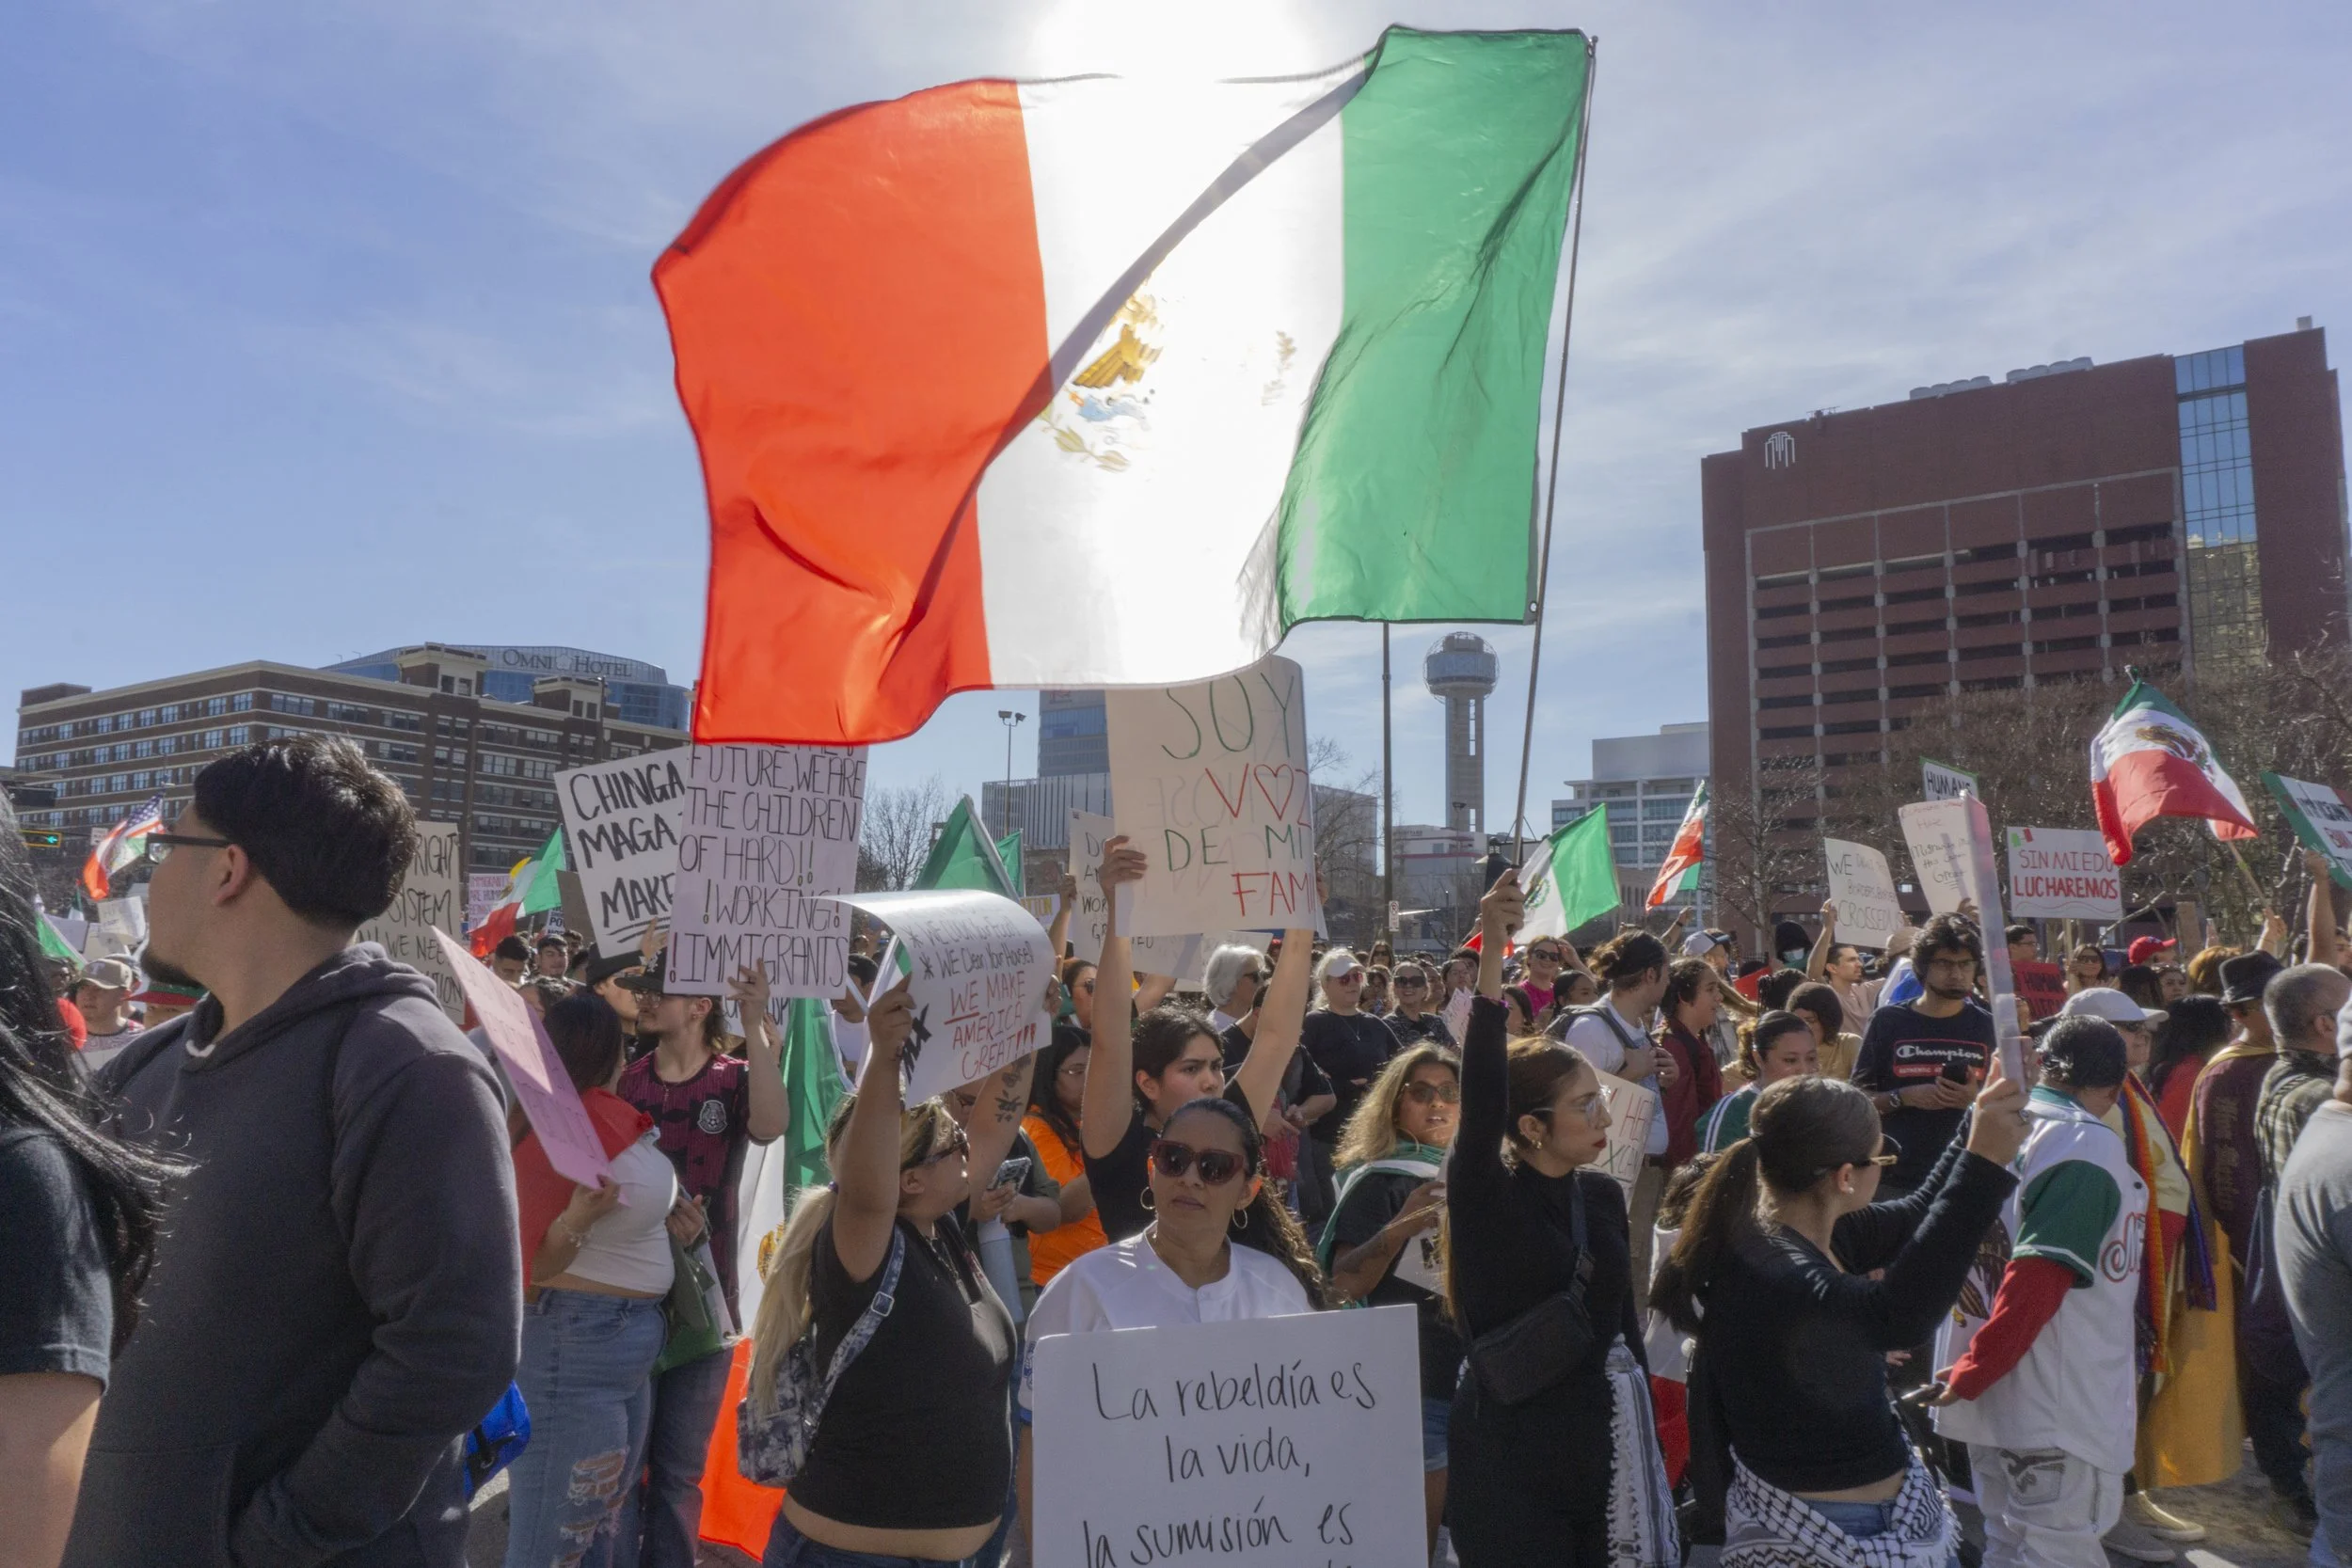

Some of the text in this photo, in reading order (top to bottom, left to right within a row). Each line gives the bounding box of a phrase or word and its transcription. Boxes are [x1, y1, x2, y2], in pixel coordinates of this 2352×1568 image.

[502, 648, 632, 677] OMNI HOTEL
[1161, 671, 1295, 760] SOY
[569, 760, 685, 821] CHINGA
[687, 786, 857, 842] THE CHILDREN
[577, 813, 679, 868] MAGA
[679, 833, 718, 873] OF
[1165, 824, 1303, 872] DE MI
[2019, 849, 2113, 873] SIN MIEDO
[2013, 874, 2119, 899] LUCHAREMOS
[950, 970, 1026, 1016] WE MAKE
[952, 1000, 1023, 1051] AMERICA
[1897, 1044, 1984, 1061] Champion
[1092, 1358, 1376, 1421] La rebeldía es
[1165, 1426, 1311, 1483] la vida,
[1083, 1496, 1355, 1568] la sumisión es
